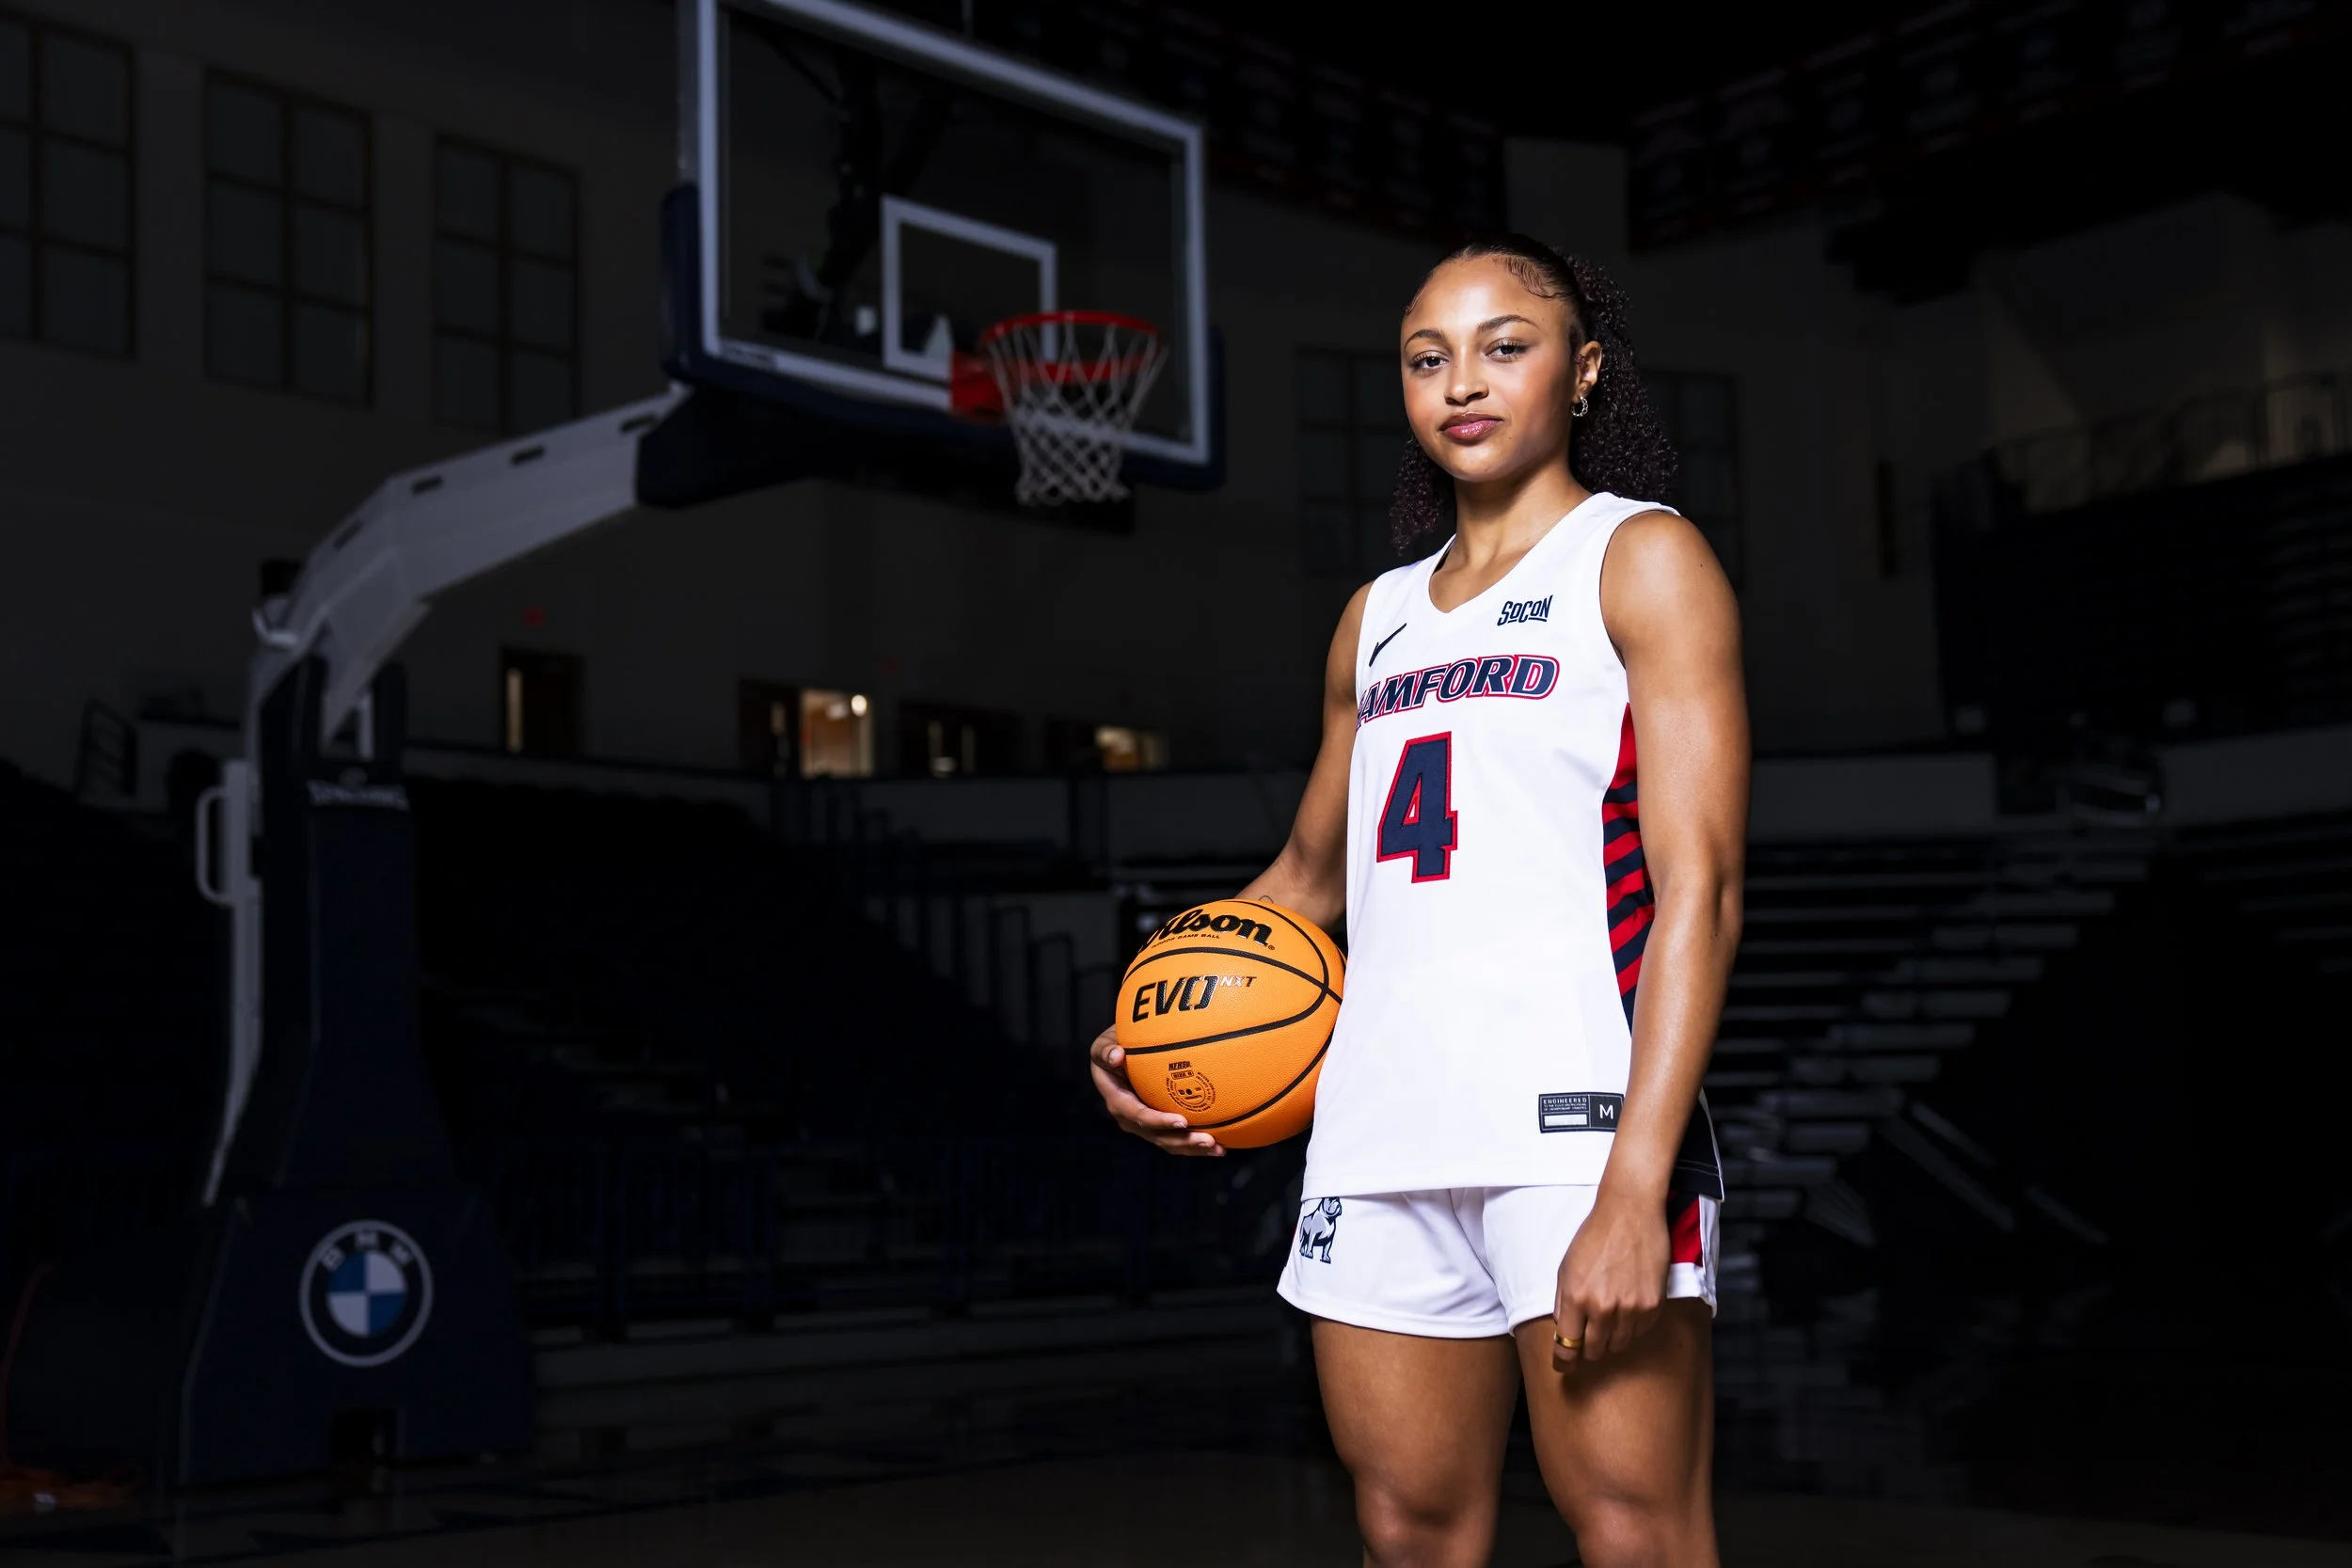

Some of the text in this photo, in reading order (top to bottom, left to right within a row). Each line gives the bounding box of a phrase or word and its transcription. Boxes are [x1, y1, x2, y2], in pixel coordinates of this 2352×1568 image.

[1356, 654, 1560, 731] AMFORD
[1376, 731, 1458, 883] 4
[1132, 974, 1257, 1022] EVO NXT
[1599, 1104, 1613, 1119] M
